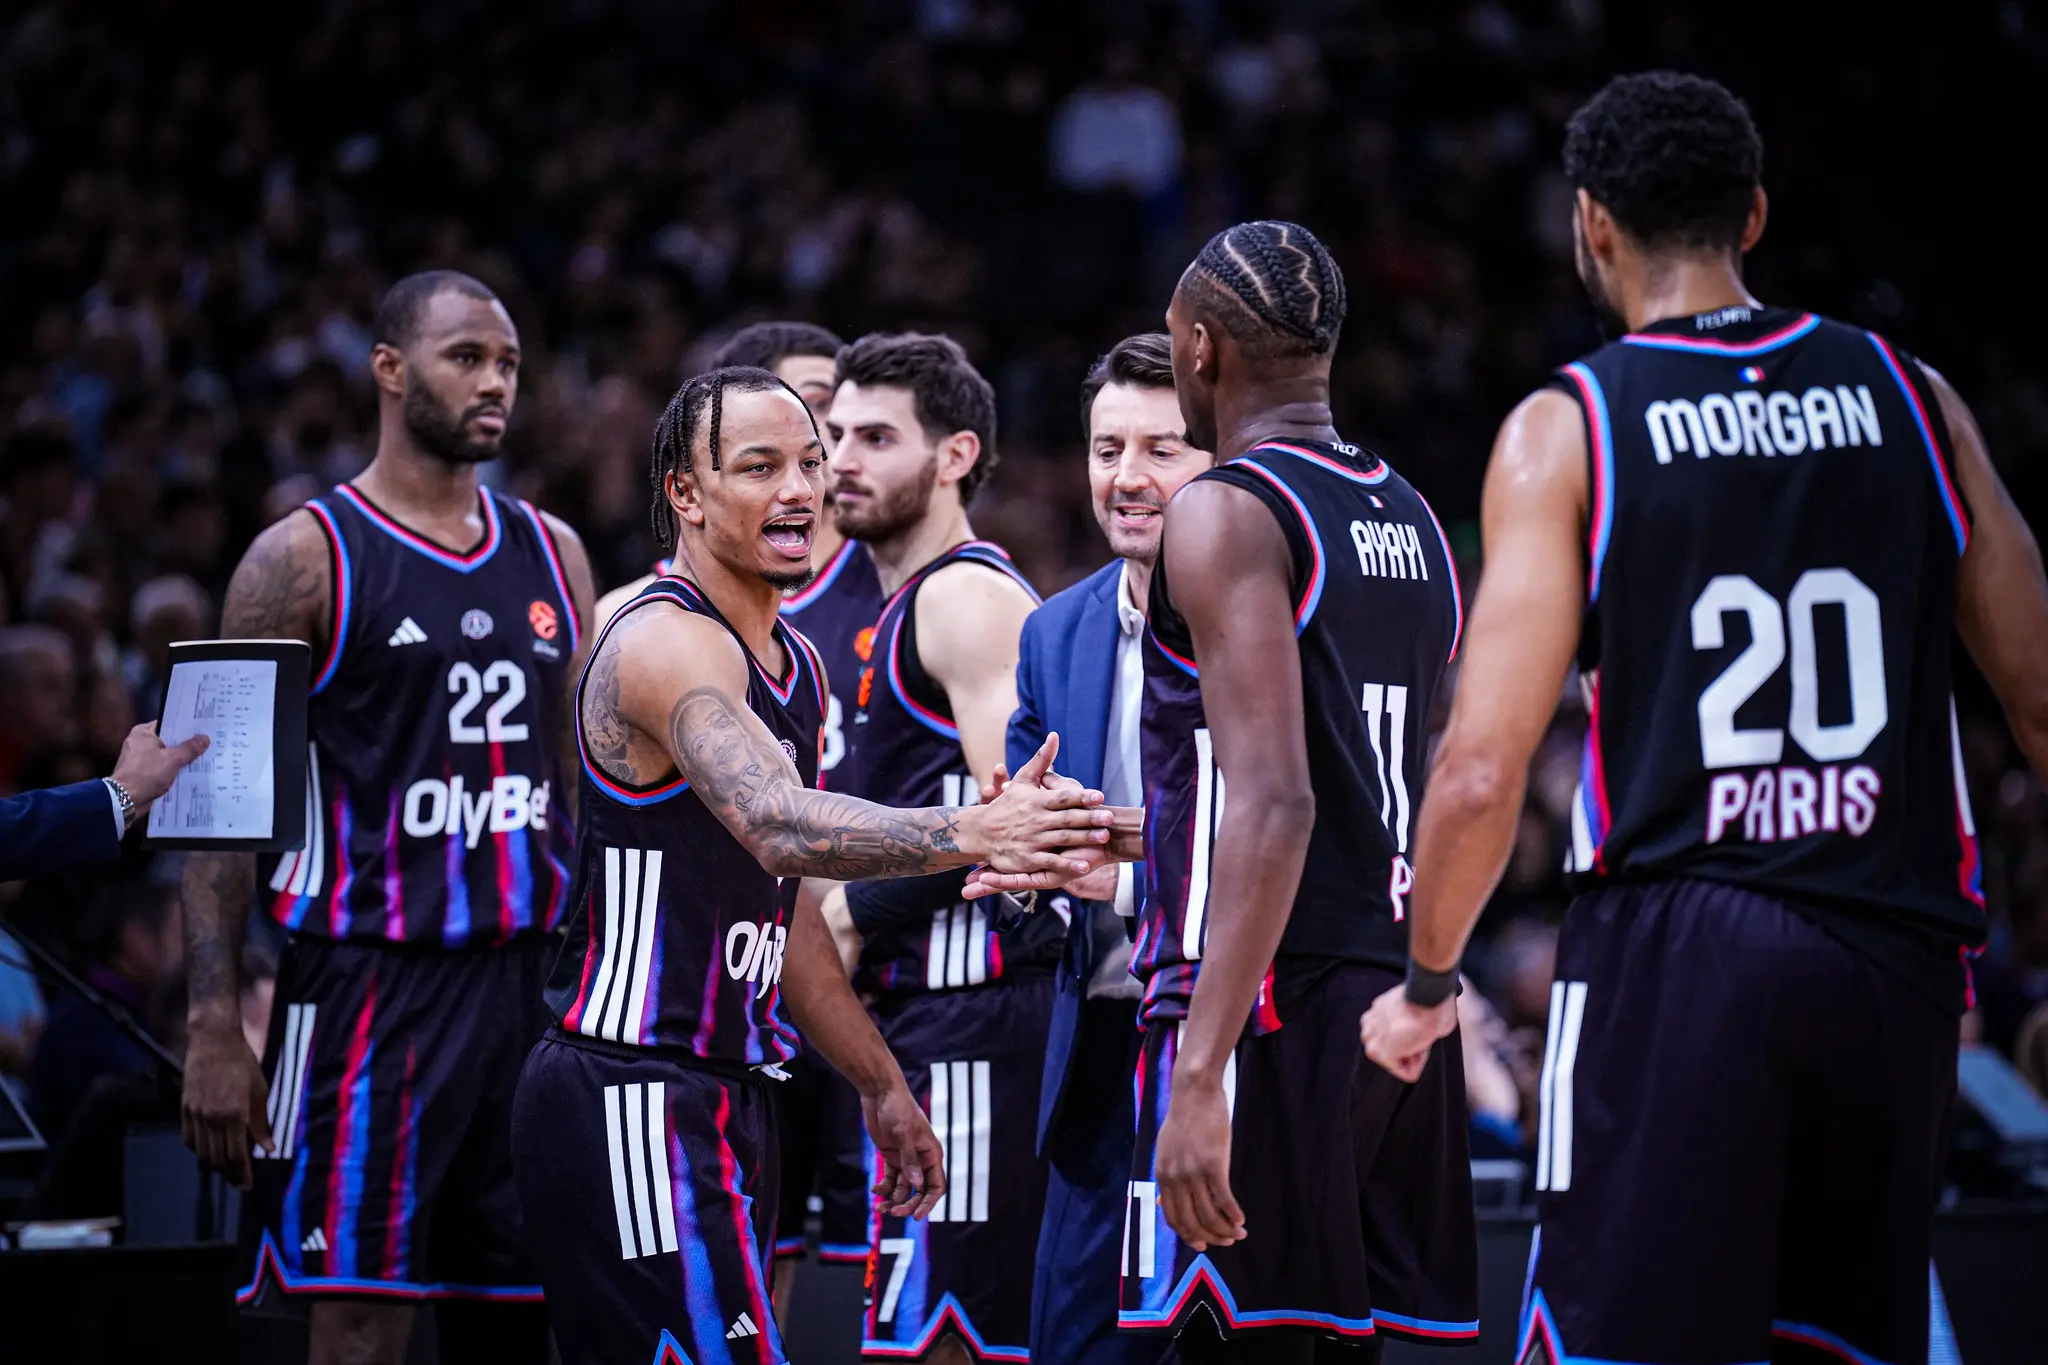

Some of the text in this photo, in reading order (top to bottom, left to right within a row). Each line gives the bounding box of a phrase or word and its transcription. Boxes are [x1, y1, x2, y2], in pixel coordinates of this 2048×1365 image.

[1645, 385, 1883, 465] MORGAN
[1350, 520, 1429, 581] AYAYI
[447, 660, 529, 743] 22
[1690, 567, 1889, 770] 20
[1361, 682, 1408, 853] 11
[1705, 764, 1883, 845] PARIS
[725, 920, 787, 1000] OlyB
[878, 1238, 915, 1323] 7
